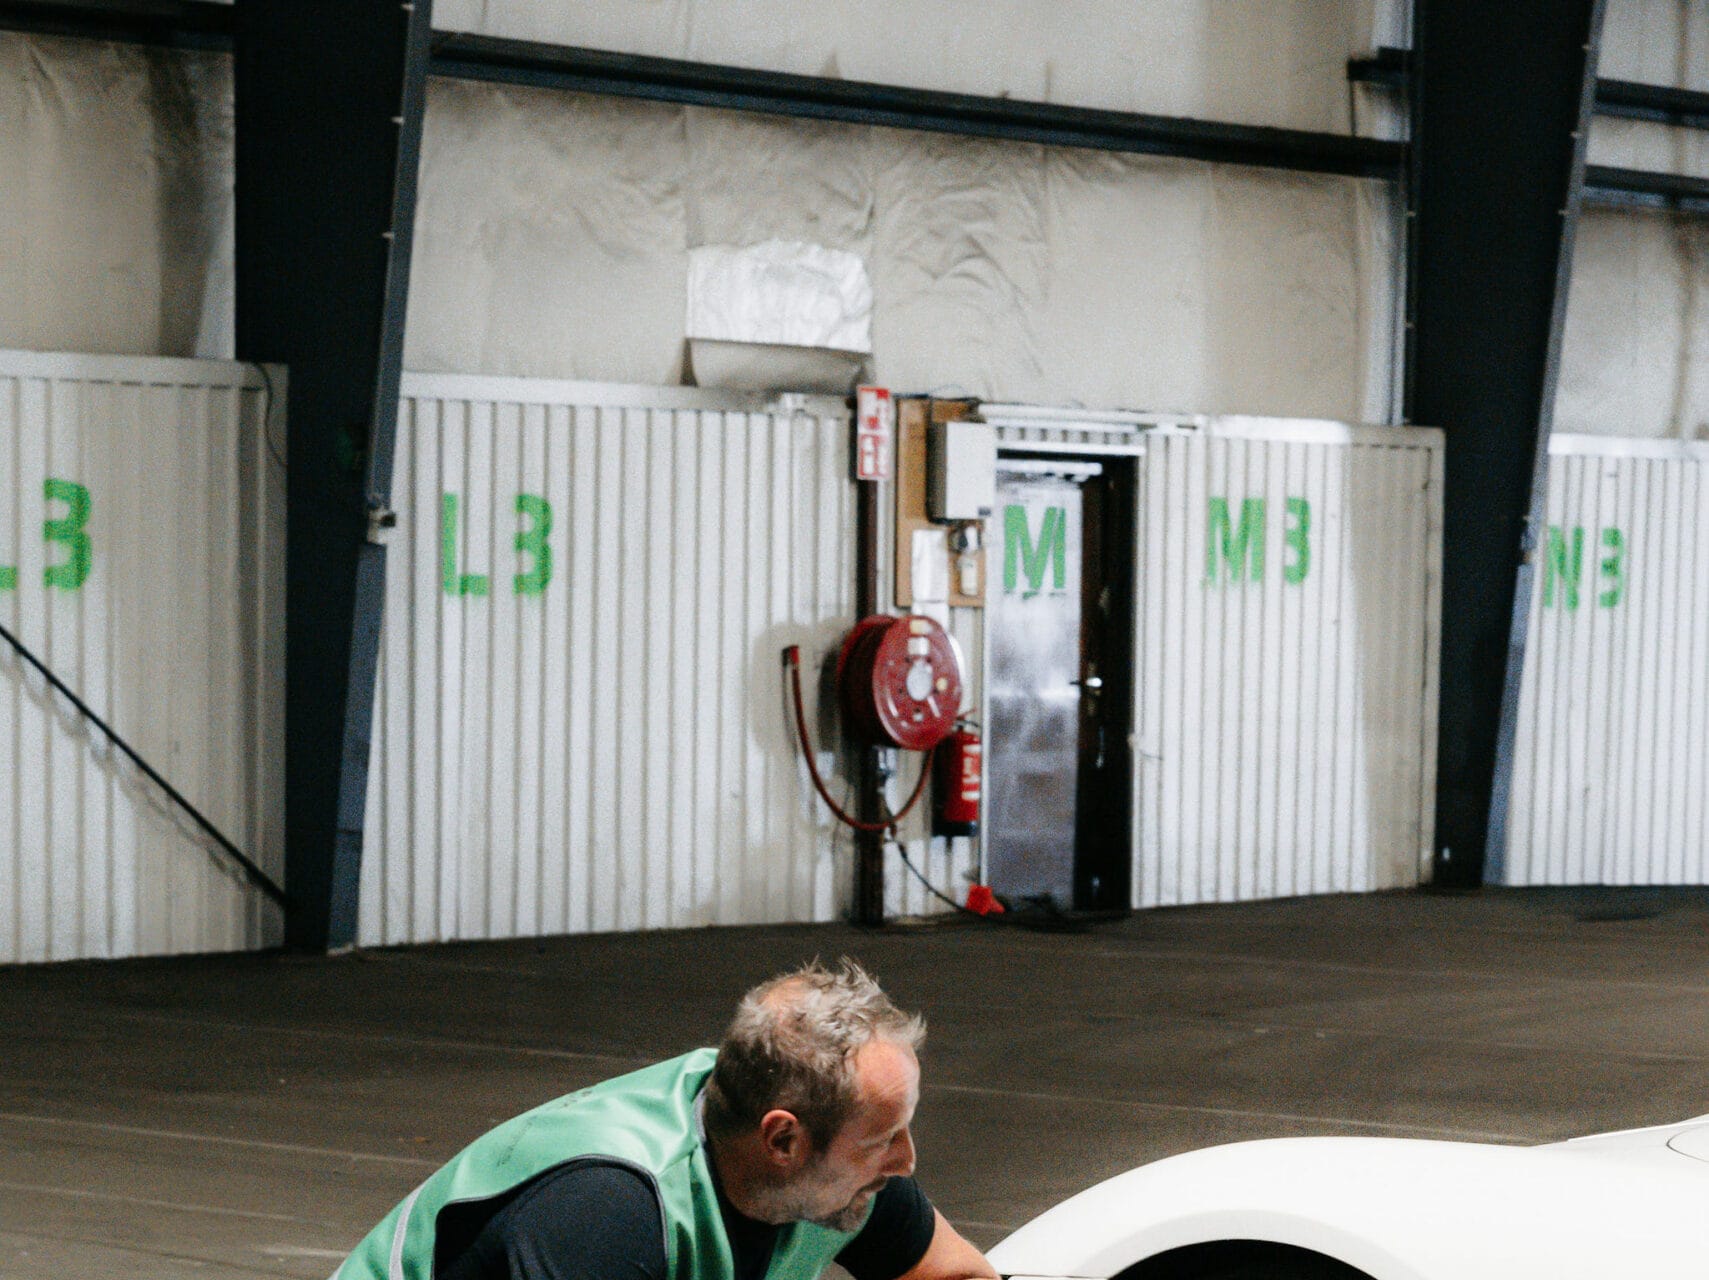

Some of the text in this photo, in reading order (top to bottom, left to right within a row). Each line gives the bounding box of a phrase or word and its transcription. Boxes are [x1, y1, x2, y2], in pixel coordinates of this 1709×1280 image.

[443, 492, 553, 597] L3
[1003, 504, 1066, 590] M
[1207, 496, 1311, 586] M3
[1543, 524, 1624, 612] N3
